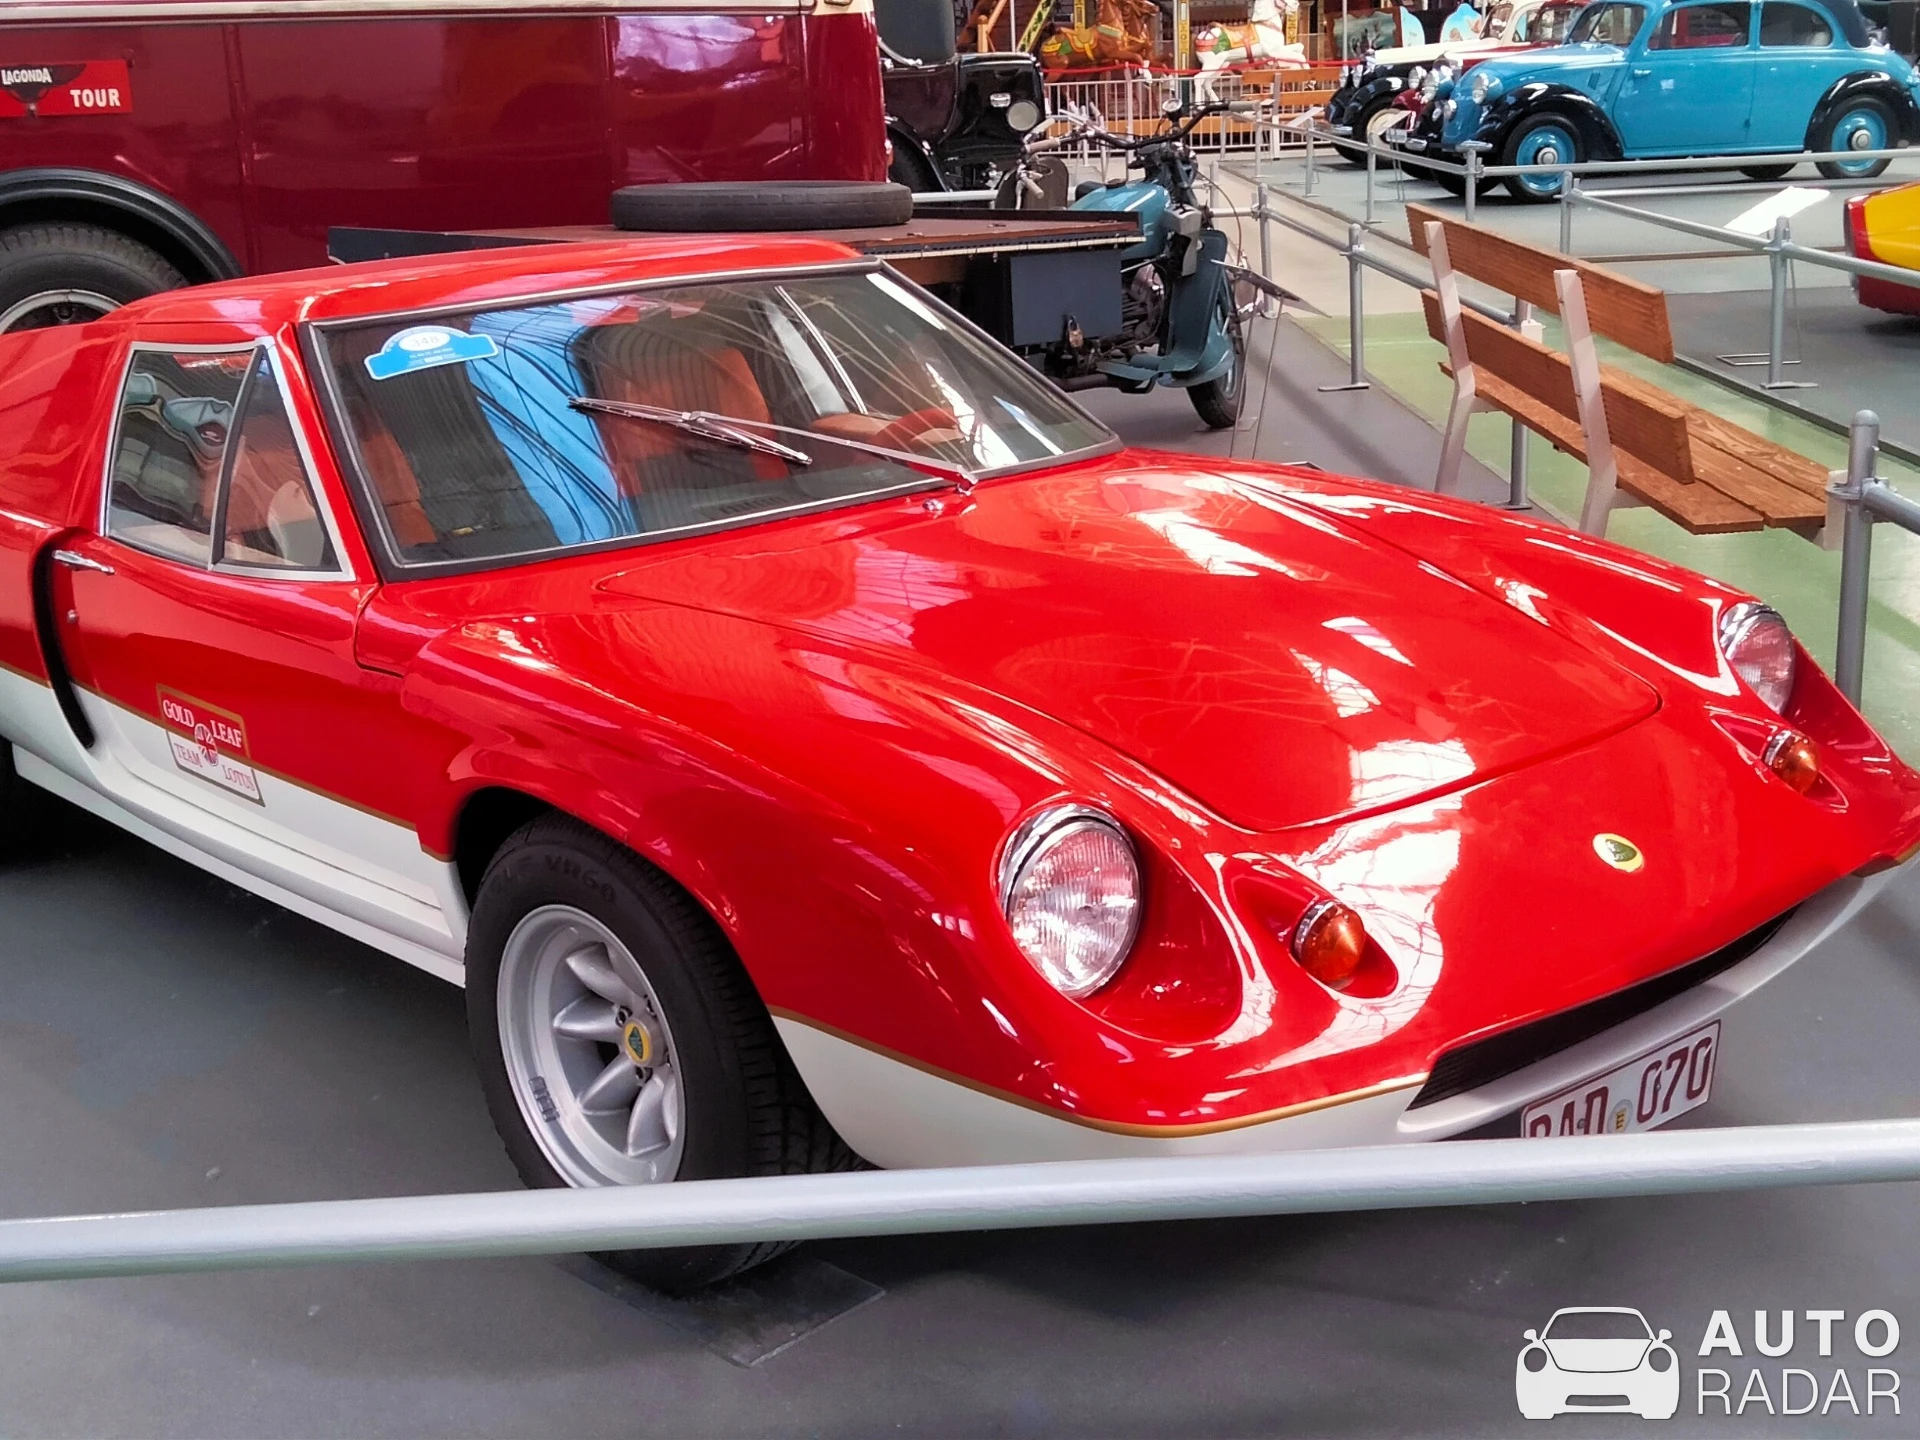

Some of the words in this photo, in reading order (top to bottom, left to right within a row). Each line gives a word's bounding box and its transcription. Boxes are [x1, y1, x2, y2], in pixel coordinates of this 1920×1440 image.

[1, 67, 52, 85] LAGONDA
[70, 88, 121, 108] TOUR
[162, 699, 195, 728] GOLD
[210, 719, 242, 748] LEAF
[174, 743, 203, 768] TEAM
[221, 764, 256, 791] LOTUS
[1637, 1036, 1712, 1124] 070
